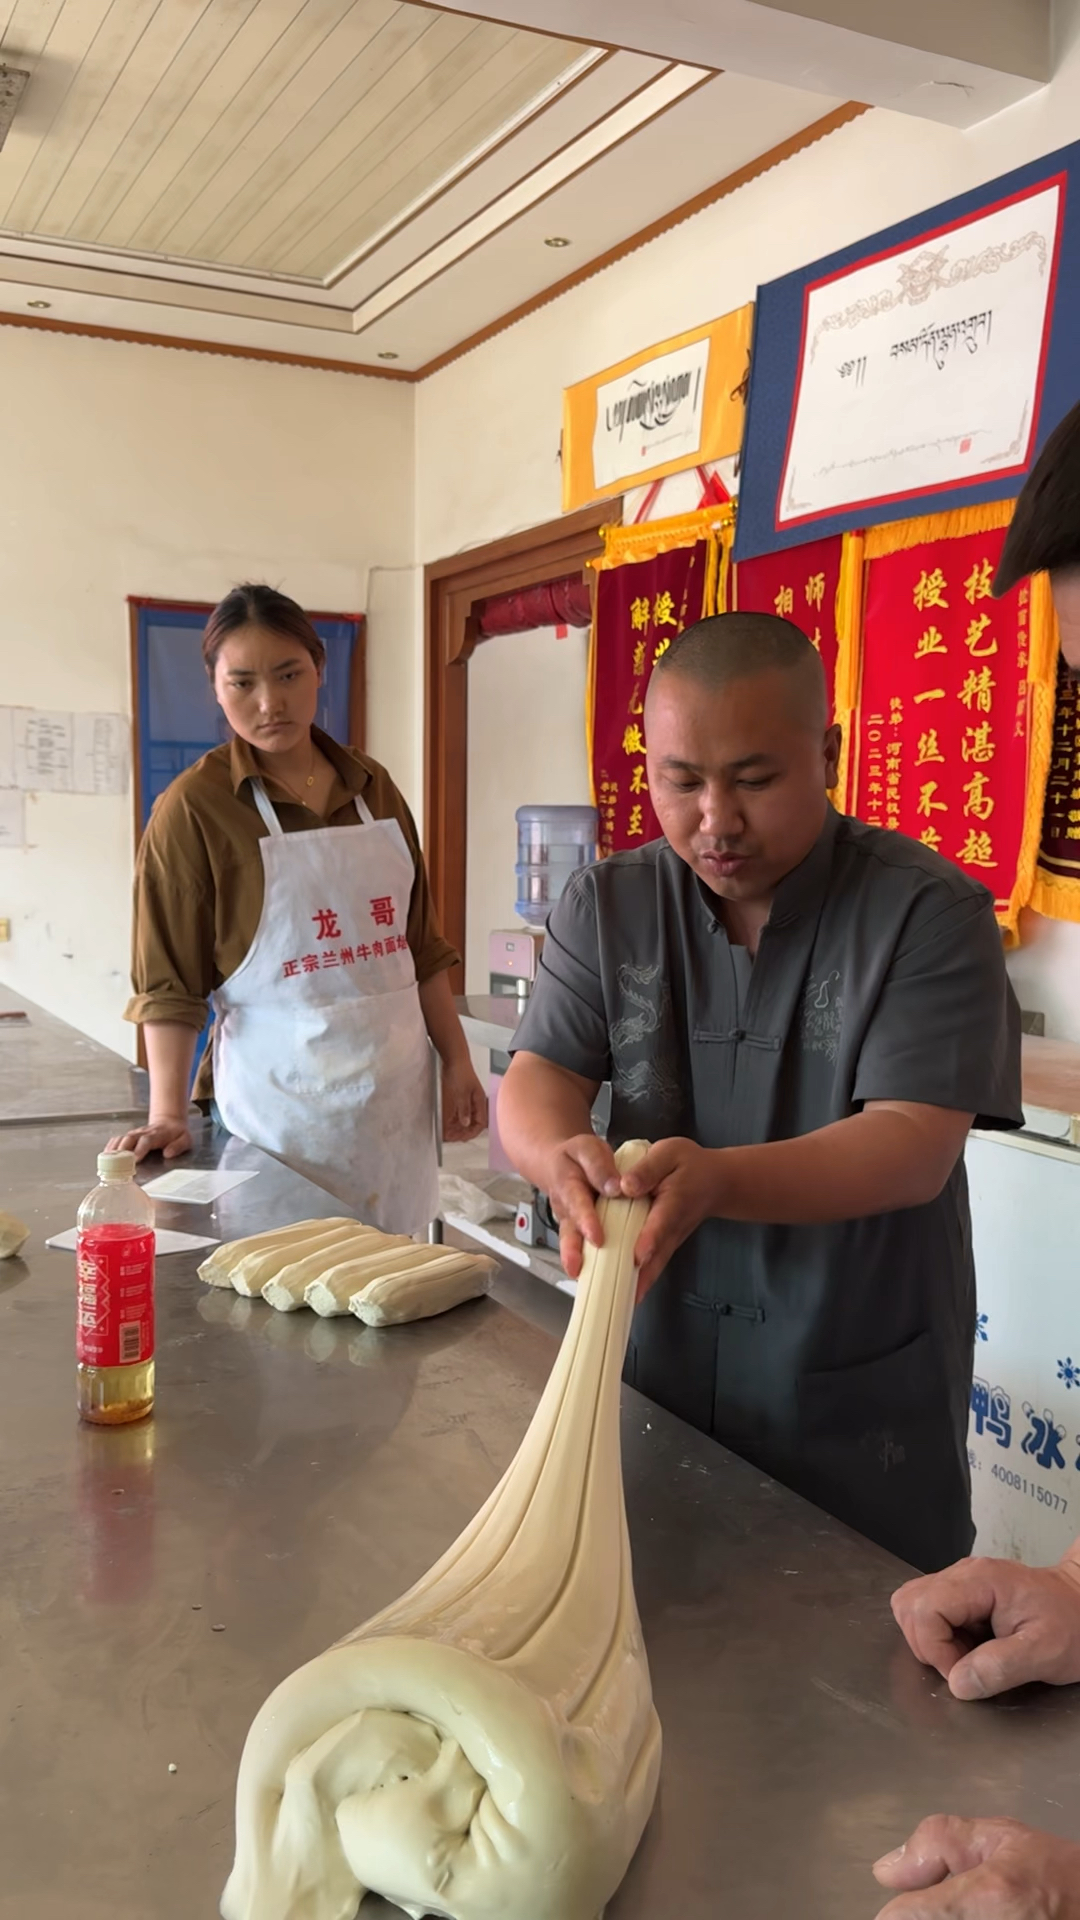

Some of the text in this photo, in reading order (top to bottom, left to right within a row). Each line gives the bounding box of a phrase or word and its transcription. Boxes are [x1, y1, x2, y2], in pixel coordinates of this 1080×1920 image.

[956, 557, 999, 868] 技艺精湛高超
[971, 1376, 1080, 1470] 鸭冰
[990, 1463, 1068, 1514] 4008115077
